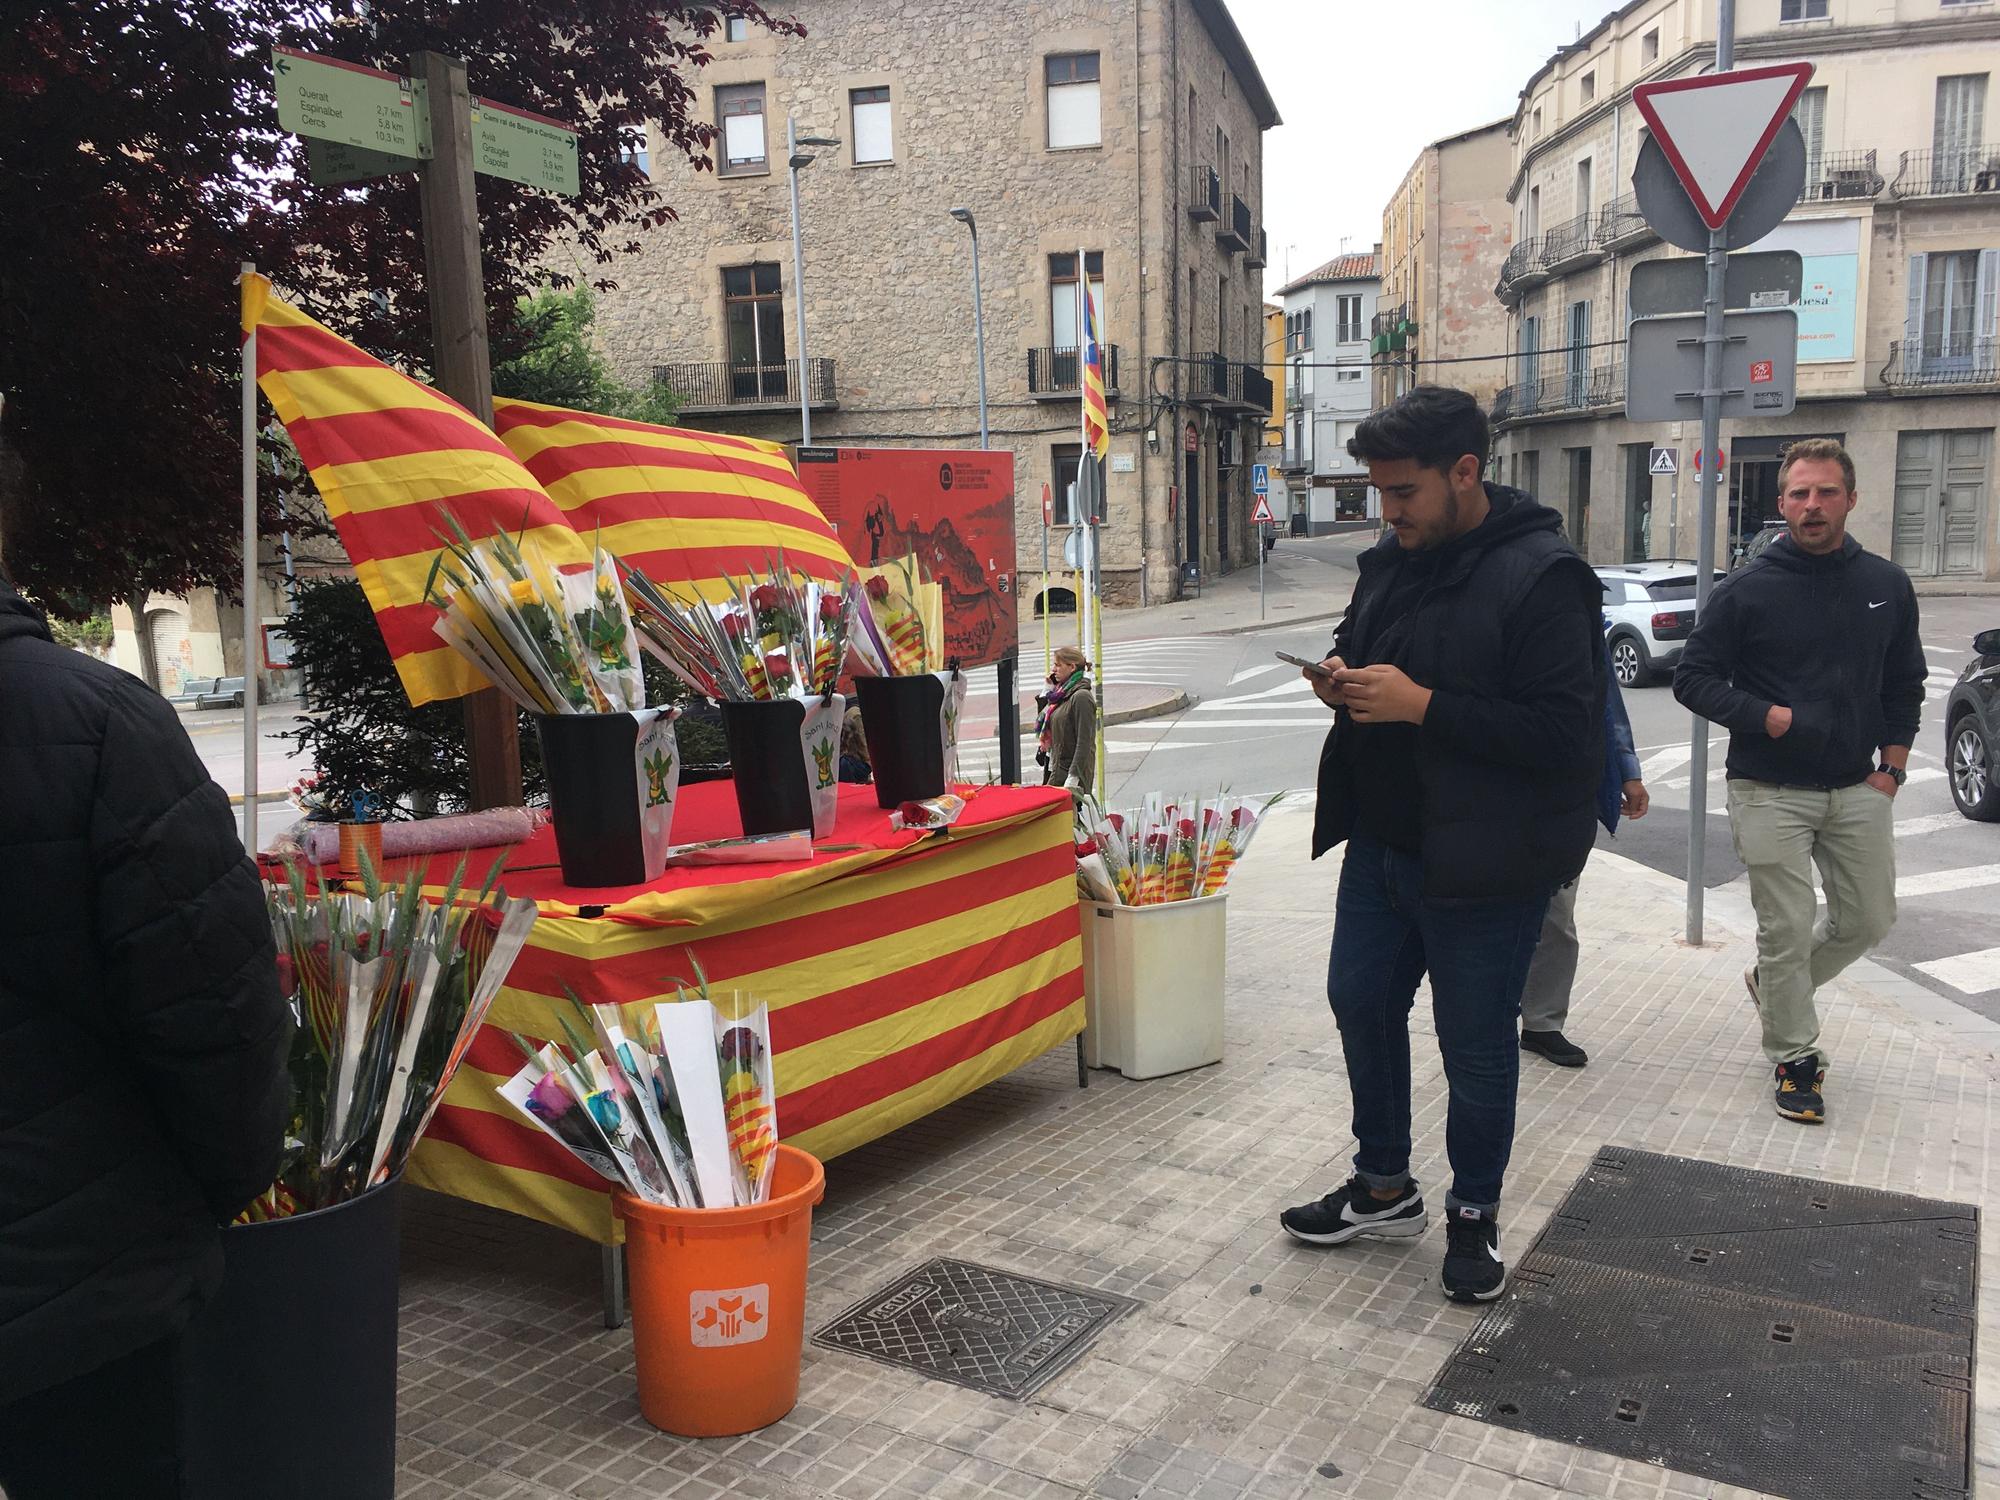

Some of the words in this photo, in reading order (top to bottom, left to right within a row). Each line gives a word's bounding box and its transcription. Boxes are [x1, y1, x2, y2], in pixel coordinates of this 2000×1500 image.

[299, 86, 329, 102] Queralt
[300, 100, 343, 119] Espinalbet
[377, 105, 389, 117] 2,7
[390, 109, 403, 119] km
[302, 114, 327, 128] Cercs
[378, 118, 391, 131] 5,8
[392, 121, 404, 133] km
[517, 123, 534, 135] Berga
[376, 130, 392, 143] 10,3
[393, 135, 405, 145] km
[553, 151, 564, 160] km
[554, 163, 564, 172] km
[555, 175, 565, 184] km
[873, 1284, 931, 1319] AGUAS
[1015, 1315, 1087, 1368] PUBLICAS
